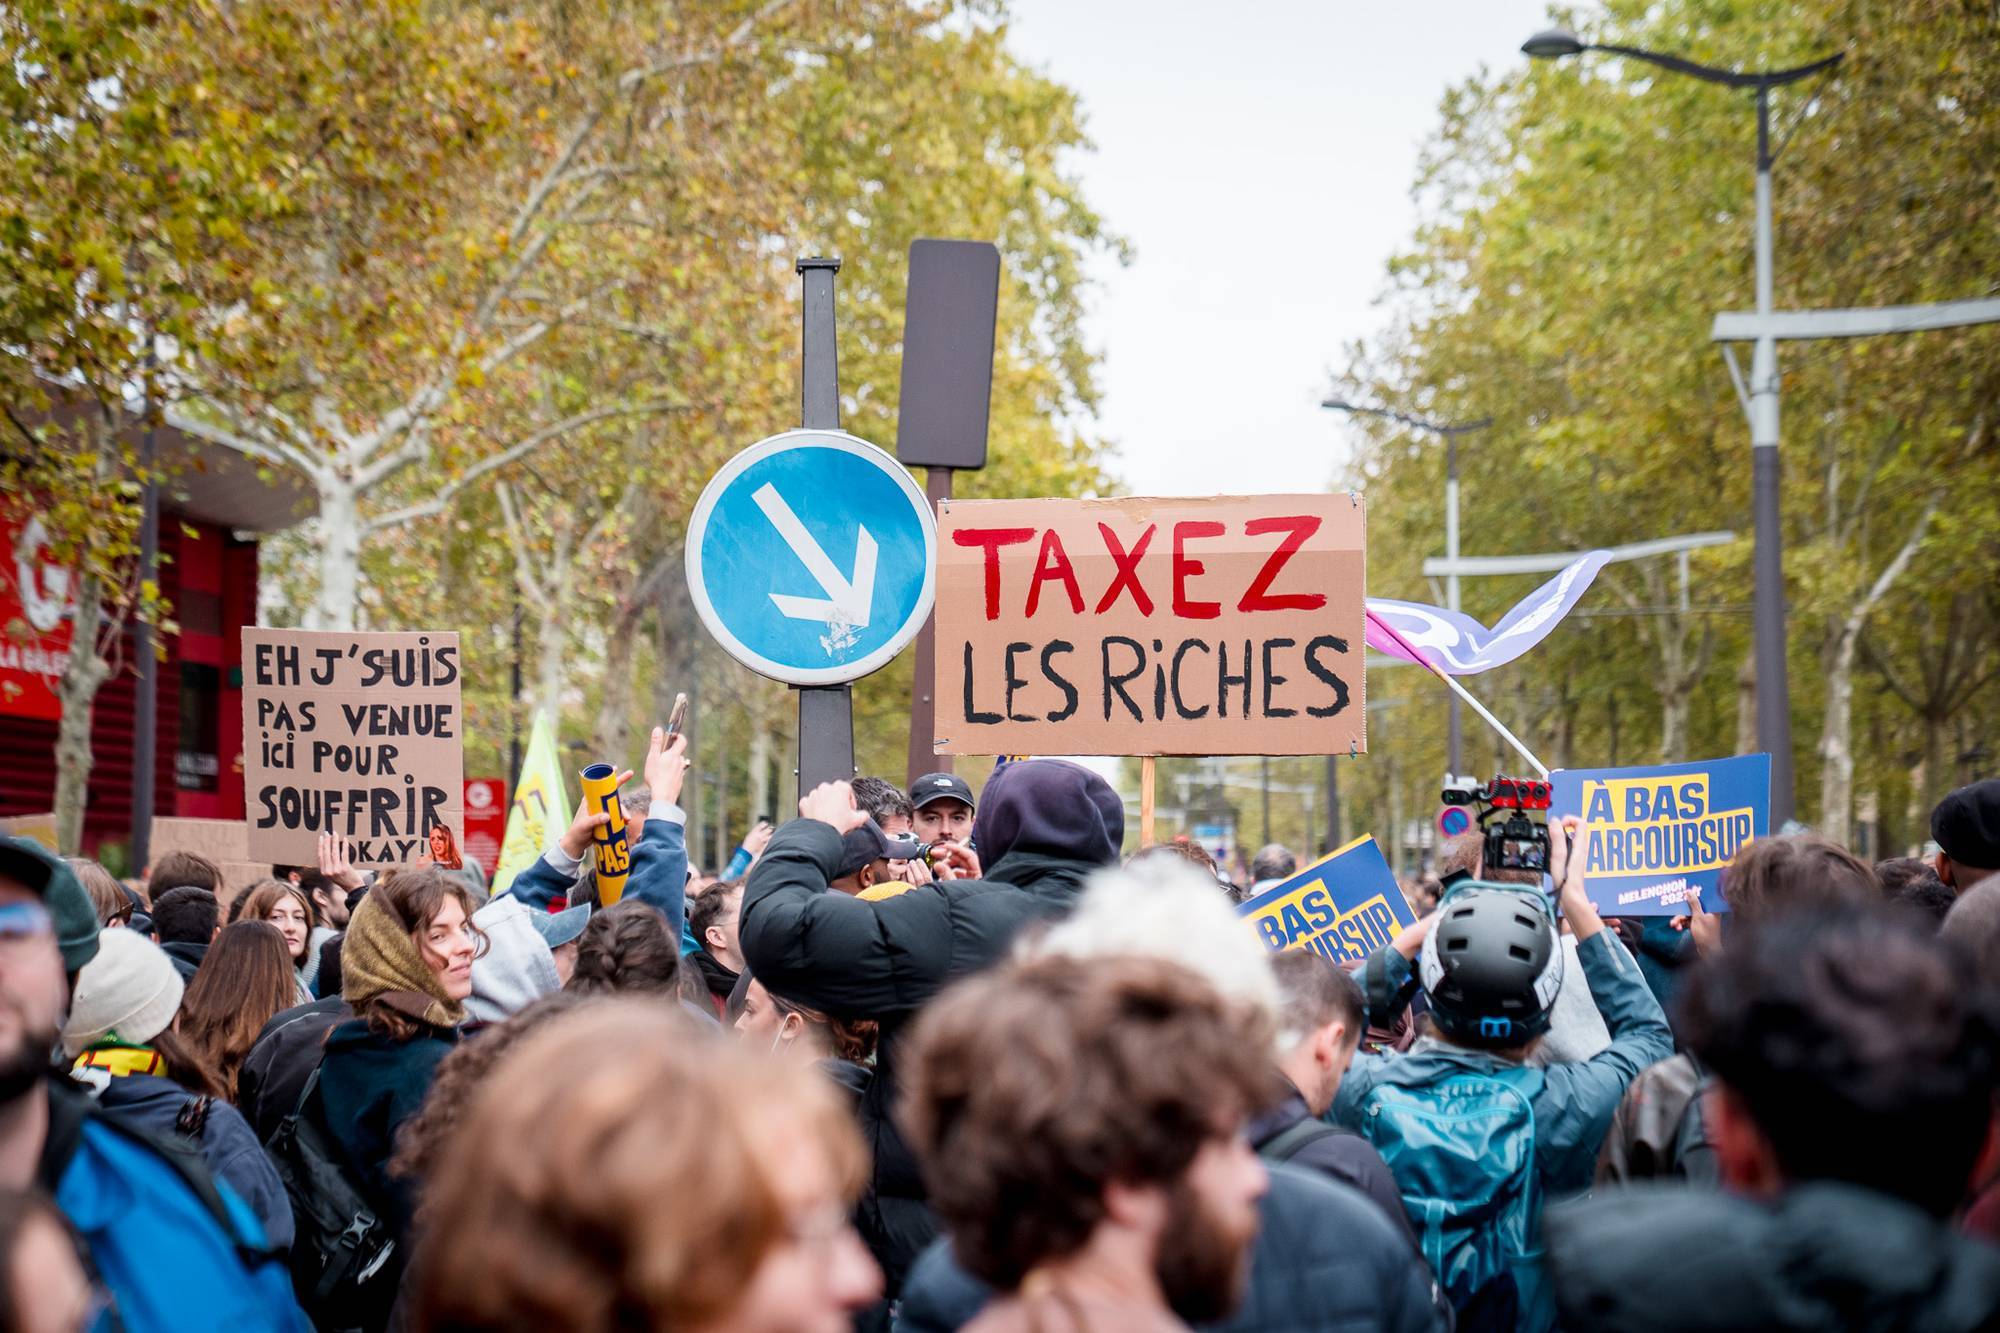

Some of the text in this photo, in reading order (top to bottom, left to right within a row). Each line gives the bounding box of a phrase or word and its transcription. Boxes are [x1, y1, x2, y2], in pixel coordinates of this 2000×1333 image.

[952, 515, 1328, 621] TAXEZ
[255, 643, 300, 686] EH
[963, 640, 1079, 725] LES
[257, 698, 453, 738] PAS VENUE
[313, 741, 399, 776] POUR
[1587, 779, 1705, 824] À BAS
[595, 839, 630, 873] PAS
[1585, 813, 1751, 873] ARCOURSUP
[1259, 890, 1336, 952] BAS
[1304, 902, 1394, 966] URSUP
